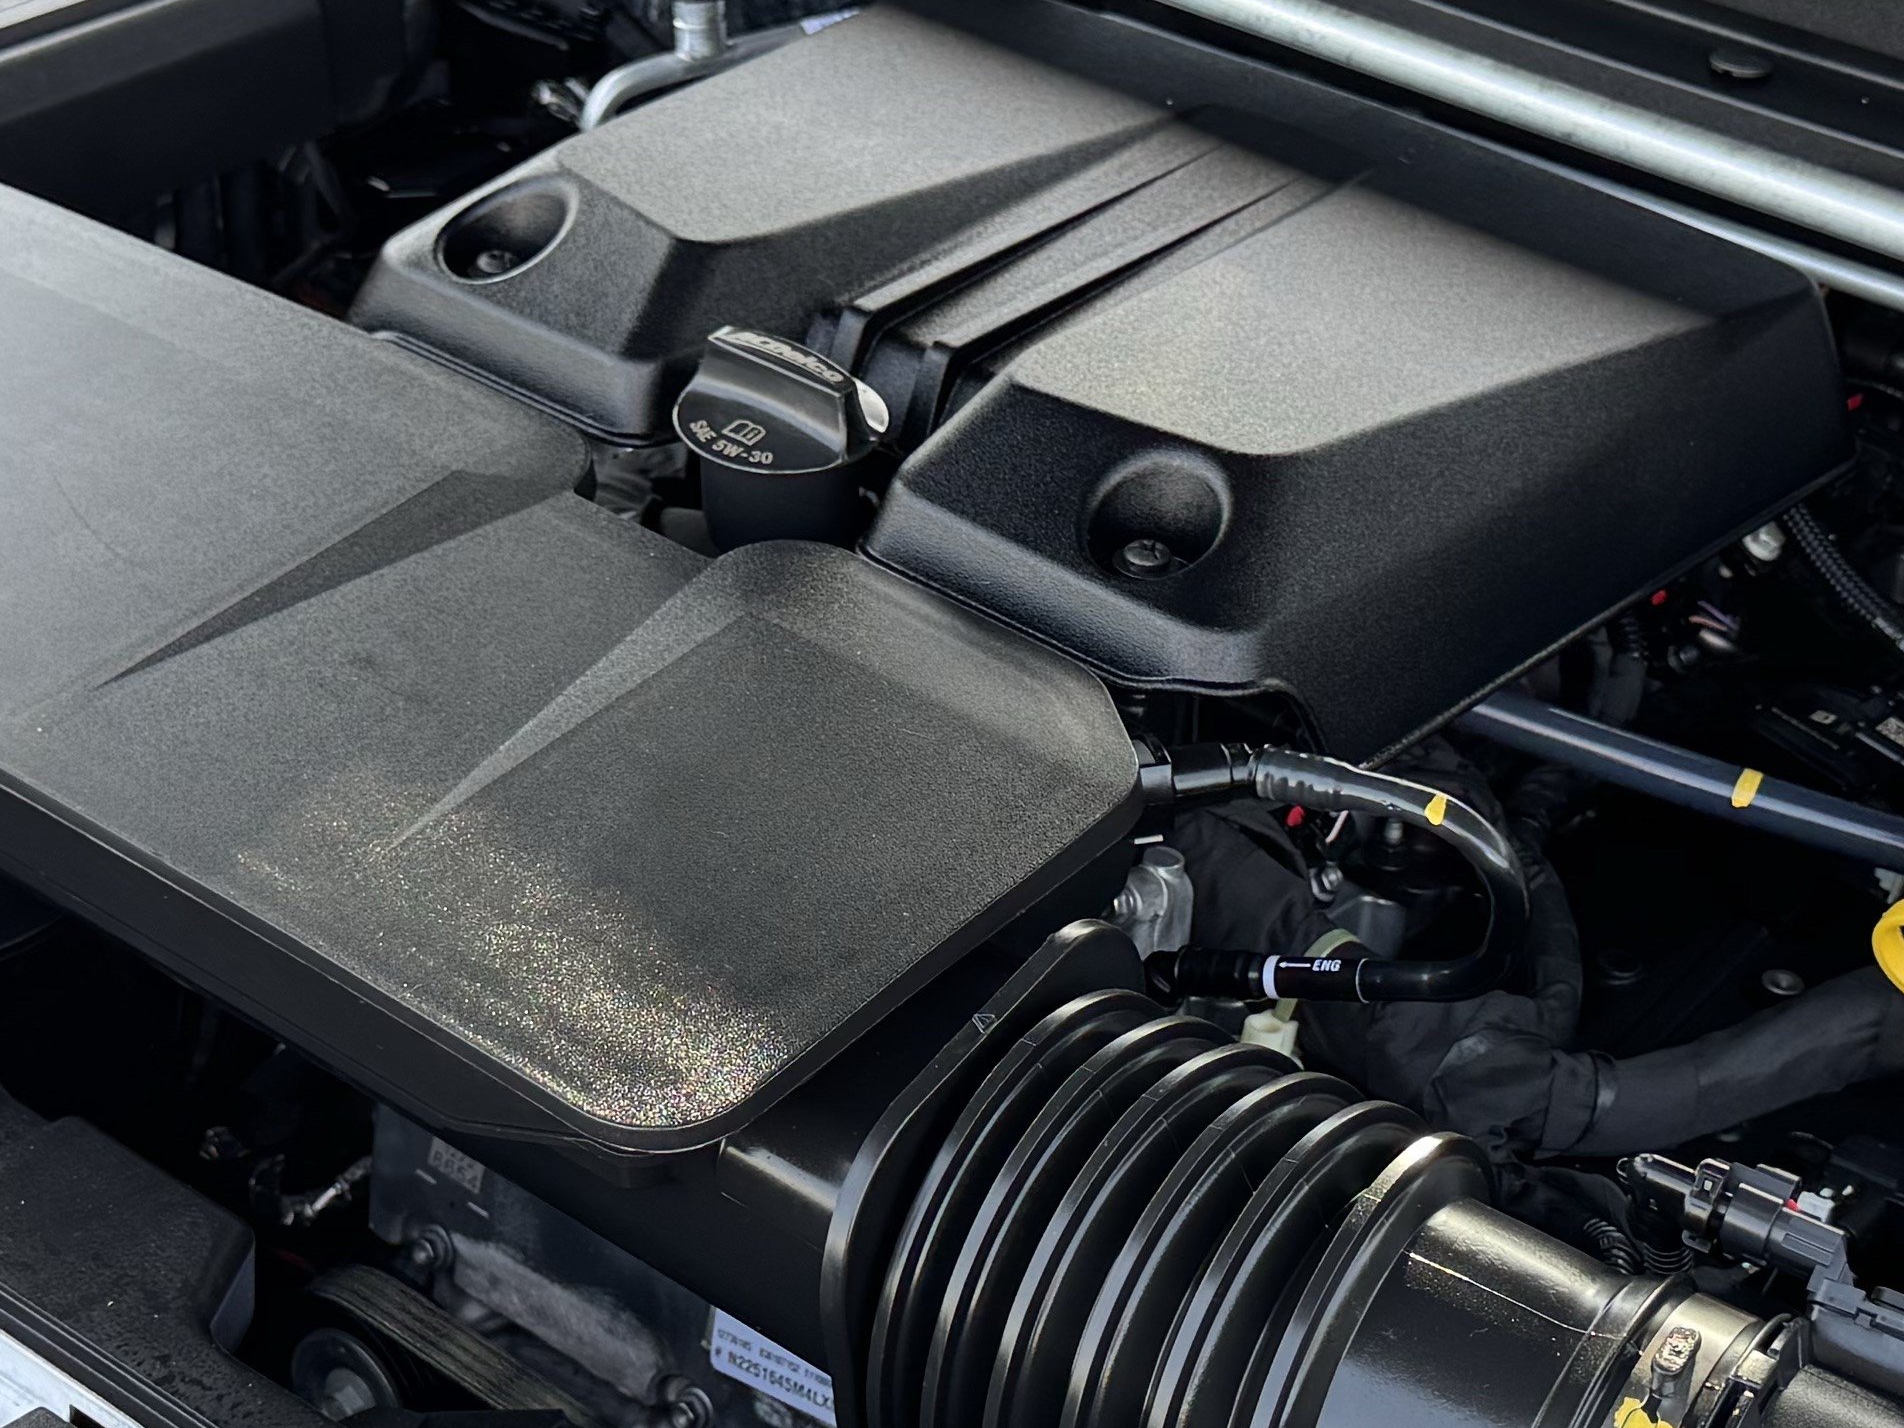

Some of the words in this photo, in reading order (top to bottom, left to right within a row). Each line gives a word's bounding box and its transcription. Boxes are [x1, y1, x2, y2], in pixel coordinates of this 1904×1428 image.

[730, 332, 845, 383] ACDelco
[690, 420, 716, 443] SAE
[712, 440, 773, 465] 5W-30
[1312, 959, 1342, 972] ENG
